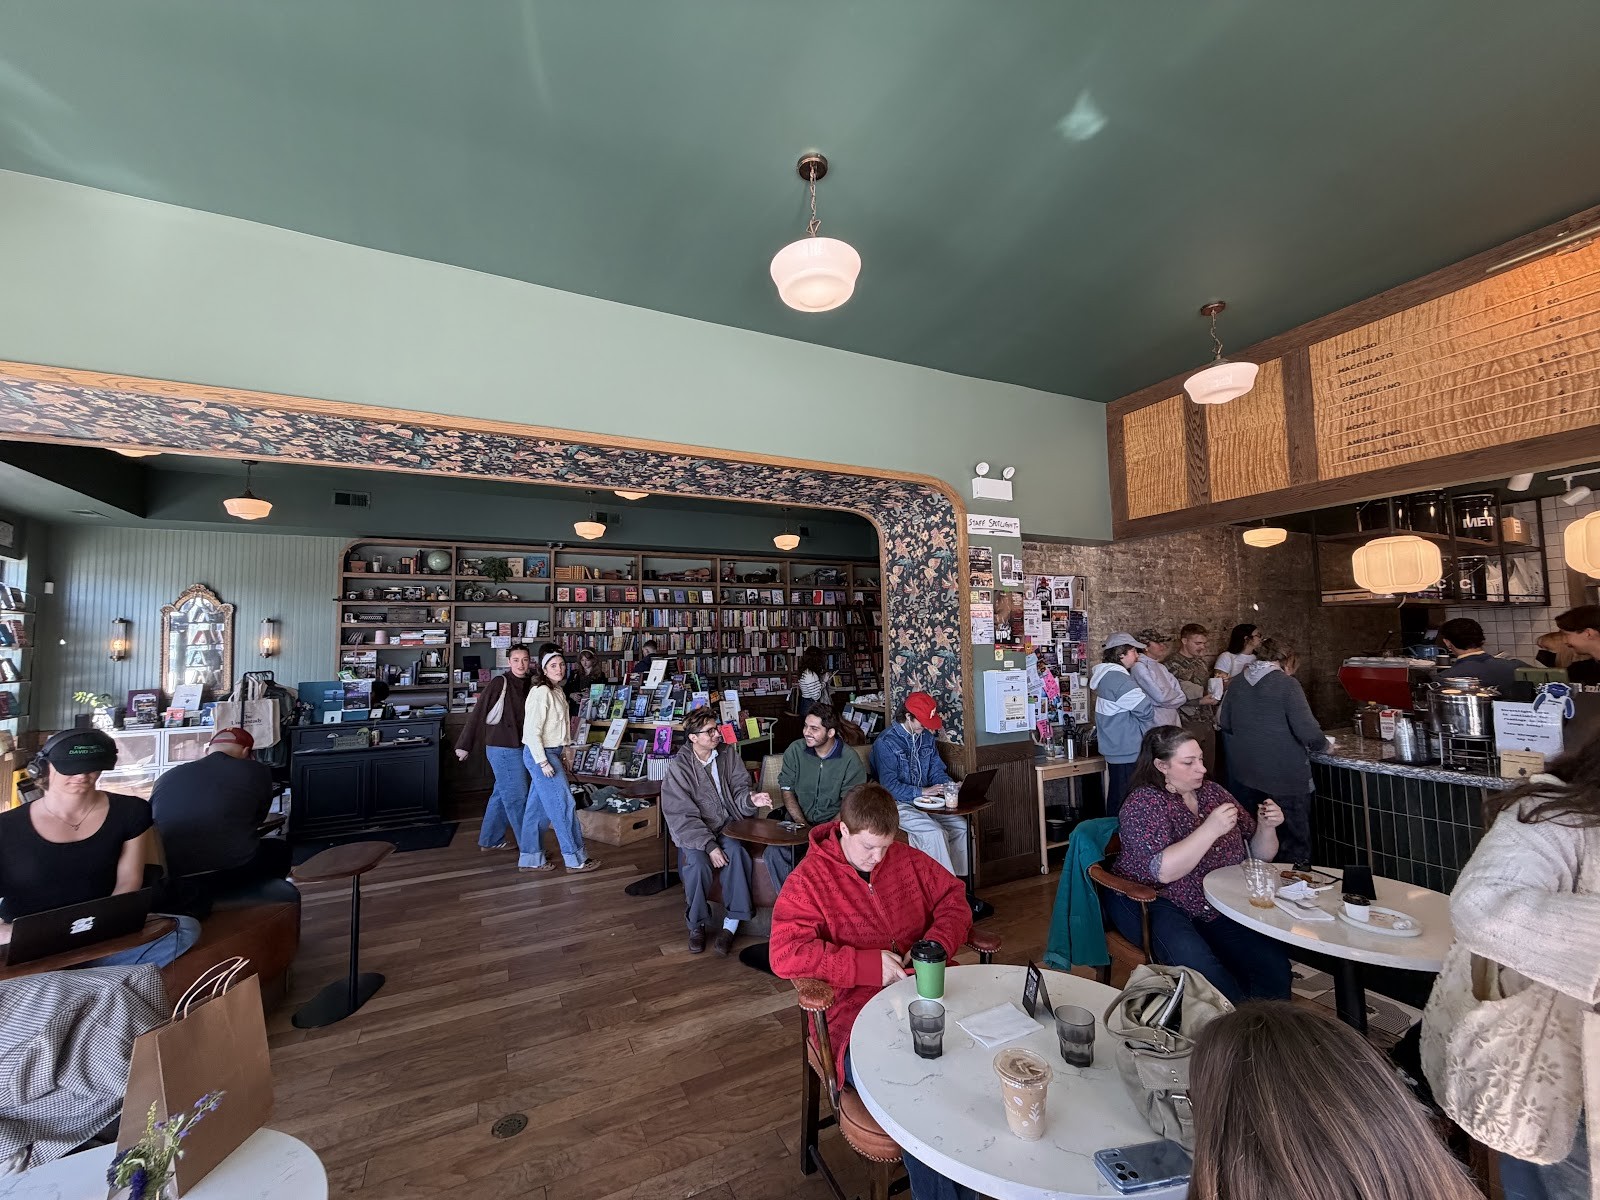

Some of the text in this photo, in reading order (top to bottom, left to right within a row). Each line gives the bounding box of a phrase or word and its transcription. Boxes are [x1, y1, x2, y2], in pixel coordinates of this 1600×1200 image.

[1335, 342, 1377, 360] ESPRESSO
[1338, 352, 1394, 374] MACCHIATO
[1339, 371, 1382, 389] CORTADO
[1342, 381, 1402, 403] CAPPUCCINO
[1344, 405, 1373, 417] LATTE
[1345, 420, 1377, 432] MOCHA
[1347, 429, 1402, 446] AMERICANO
[1347, 447, 1389, 461] ESPRESSO
[1392, 439, 1425, 451] TONIC
[968, 518, 986, 527] STAFF
